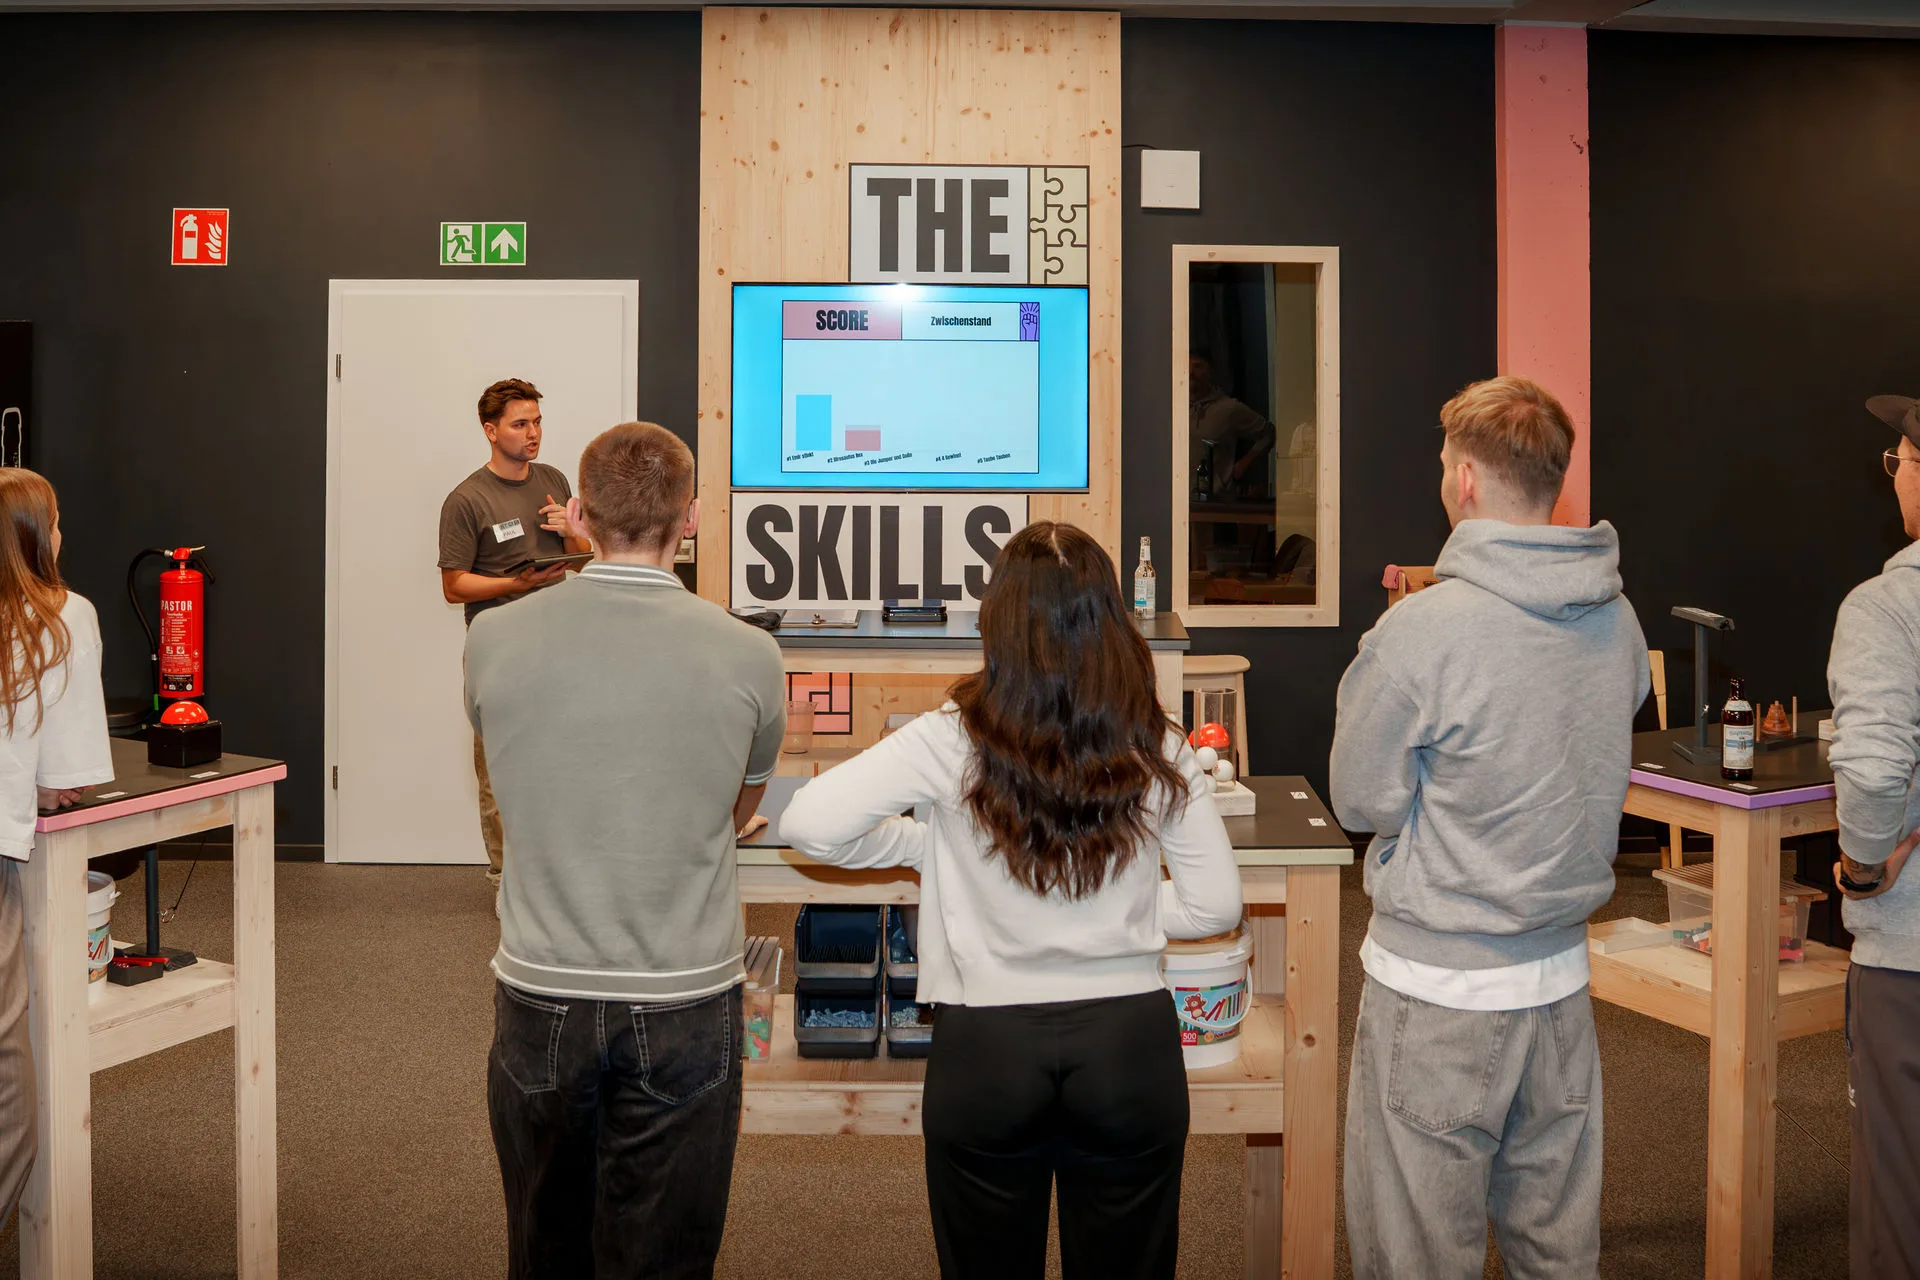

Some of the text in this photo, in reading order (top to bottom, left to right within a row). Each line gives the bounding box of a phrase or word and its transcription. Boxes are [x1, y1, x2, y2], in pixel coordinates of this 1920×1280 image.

[867, 178, 1010, 273] THE
[816, 309, 869, 331] SCORE
[930, 315, 992, 327] Zwischenstand
[746, 504, 1012, 601] SKILLS
[161, 600, 192, 611] PASTOR
